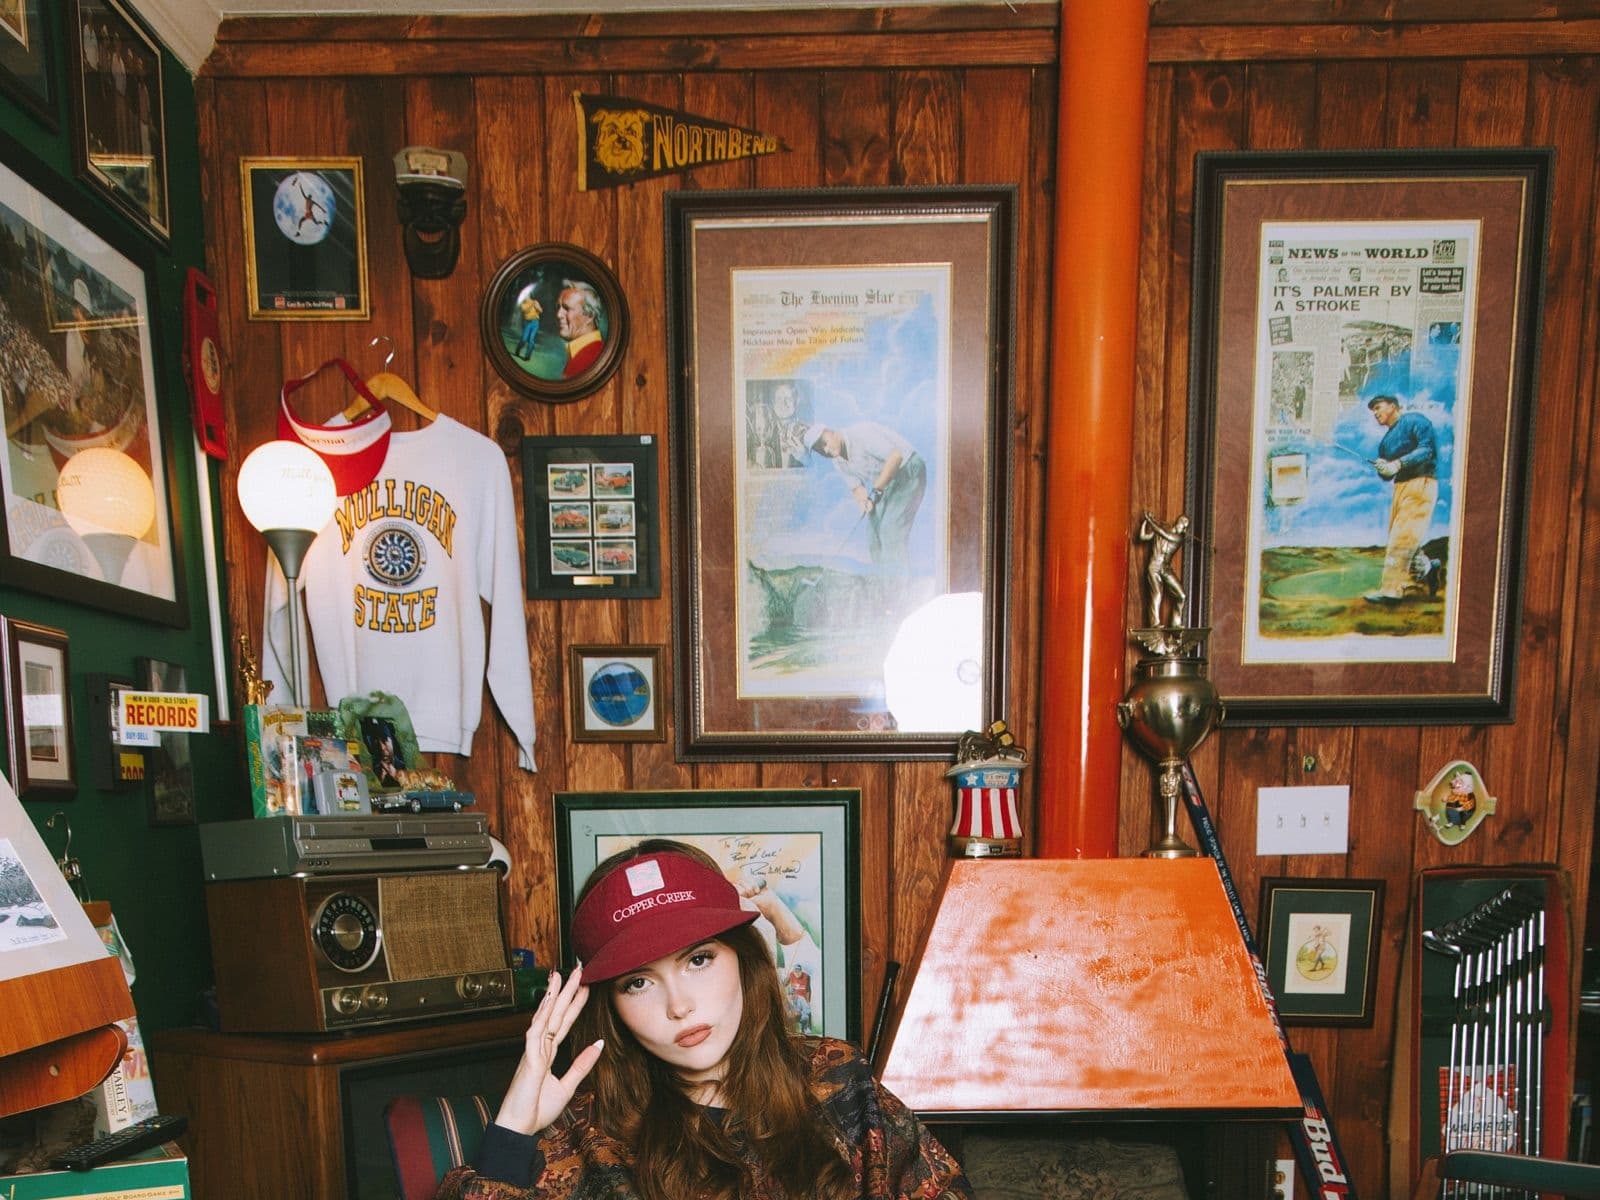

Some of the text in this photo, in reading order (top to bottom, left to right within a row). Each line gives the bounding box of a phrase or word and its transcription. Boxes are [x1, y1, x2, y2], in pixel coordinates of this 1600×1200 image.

[1288, 248, 1339, 259] NEWS
[1364, 247, 1429, 259] WORLD
[780, 290, 804, 308] The
[811, 290, 859, 307] Evening
[865, 288, 896, 305] Star
[1273, 285, 1412, 298] IT'S PALMER BY
[1274, 299, 1361, 312] A STROKE
[334, 479, 457, 560] MULLIGAN
[354, 583, 438, 633] STATE
[126, 704, 198, 729] RECORDS
[613, 890, 697, 923] COPPER CREEK
[1303, 1116, 1347, 1186] Bud
